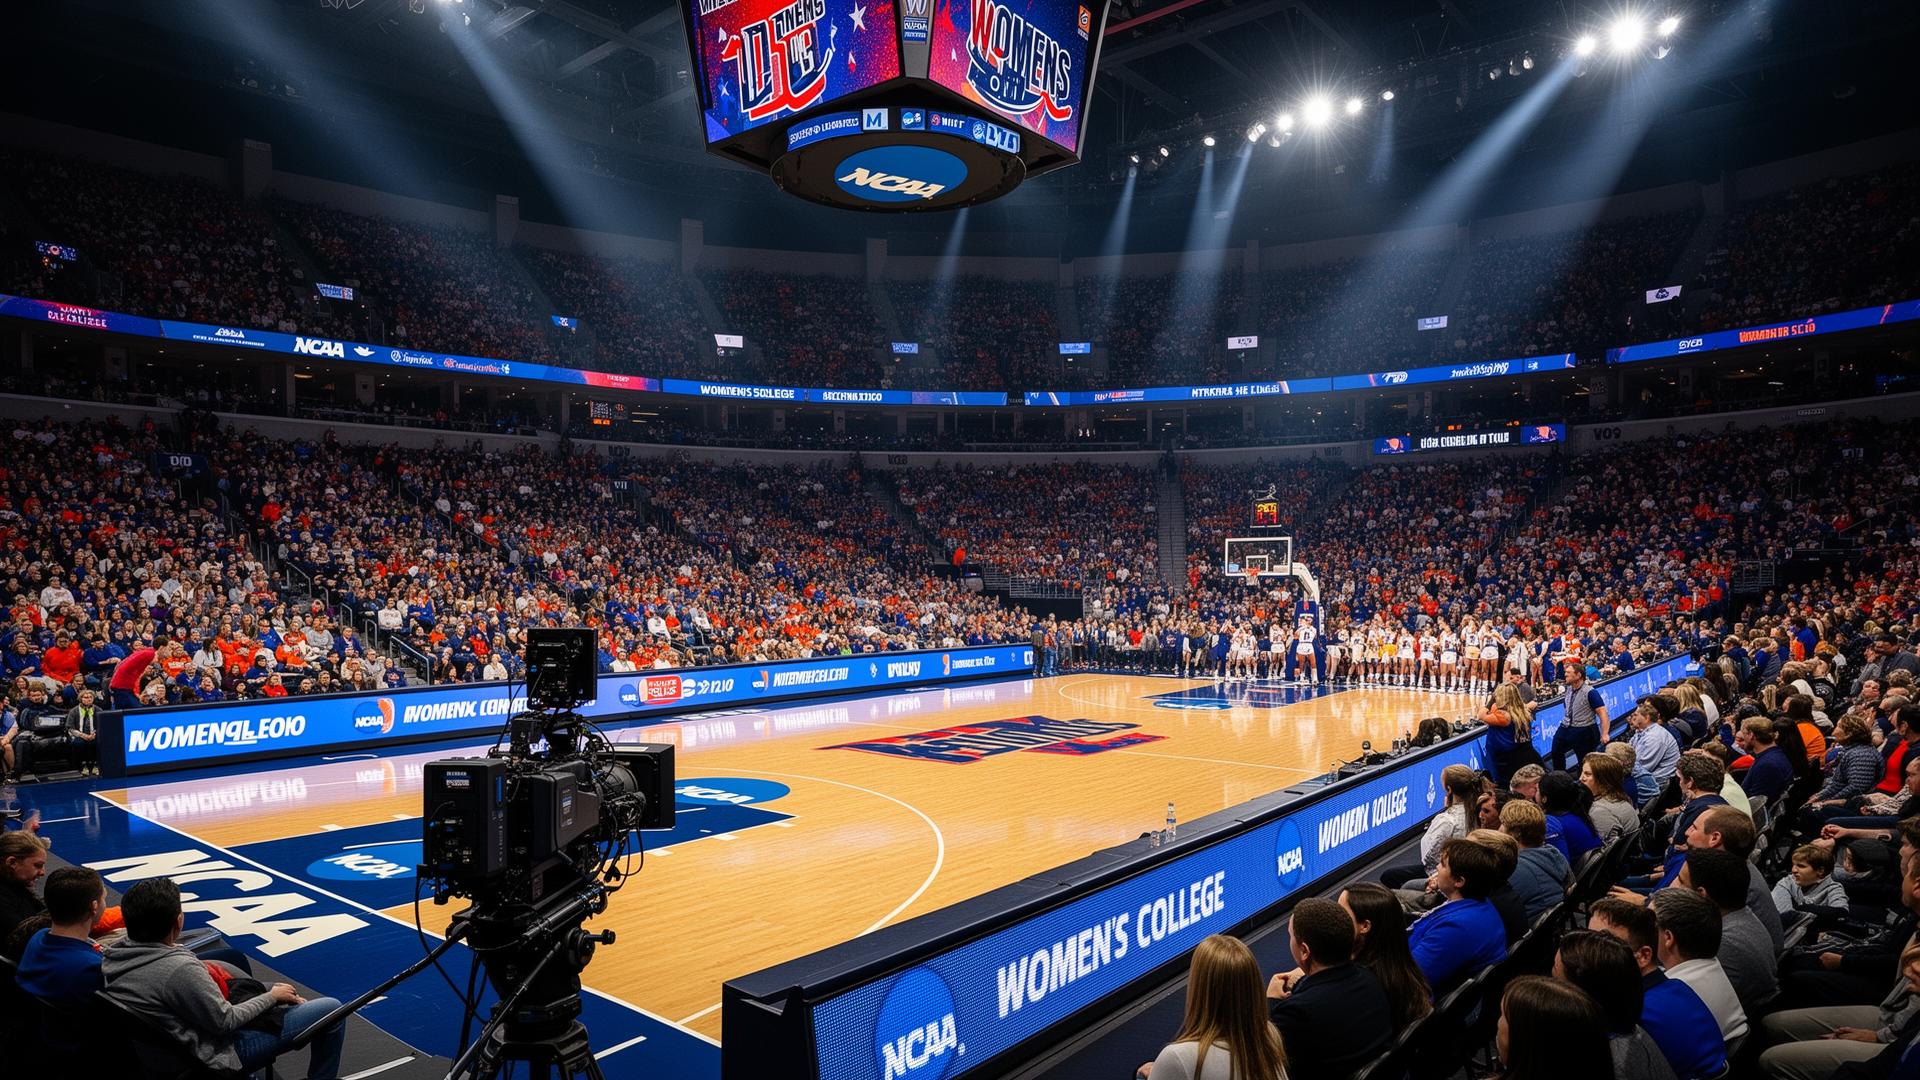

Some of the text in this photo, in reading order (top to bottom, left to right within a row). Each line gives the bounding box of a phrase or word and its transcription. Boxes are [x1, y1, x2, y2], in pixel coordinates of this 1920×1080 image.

[866, 112, 882, 128] M
[838, 167, 945, 198] NCAA
[293, 336, 344, 359] NCAA
[324, 853, 412, 879] NCAA
[1277, 847, 1303, 877] NCAA
[81, 849, 371, 957] NCAA
[997, 871, 1225, 1019] WOMEN'S COLLEGE
[882, 1013, 958, 1080] NCAA
